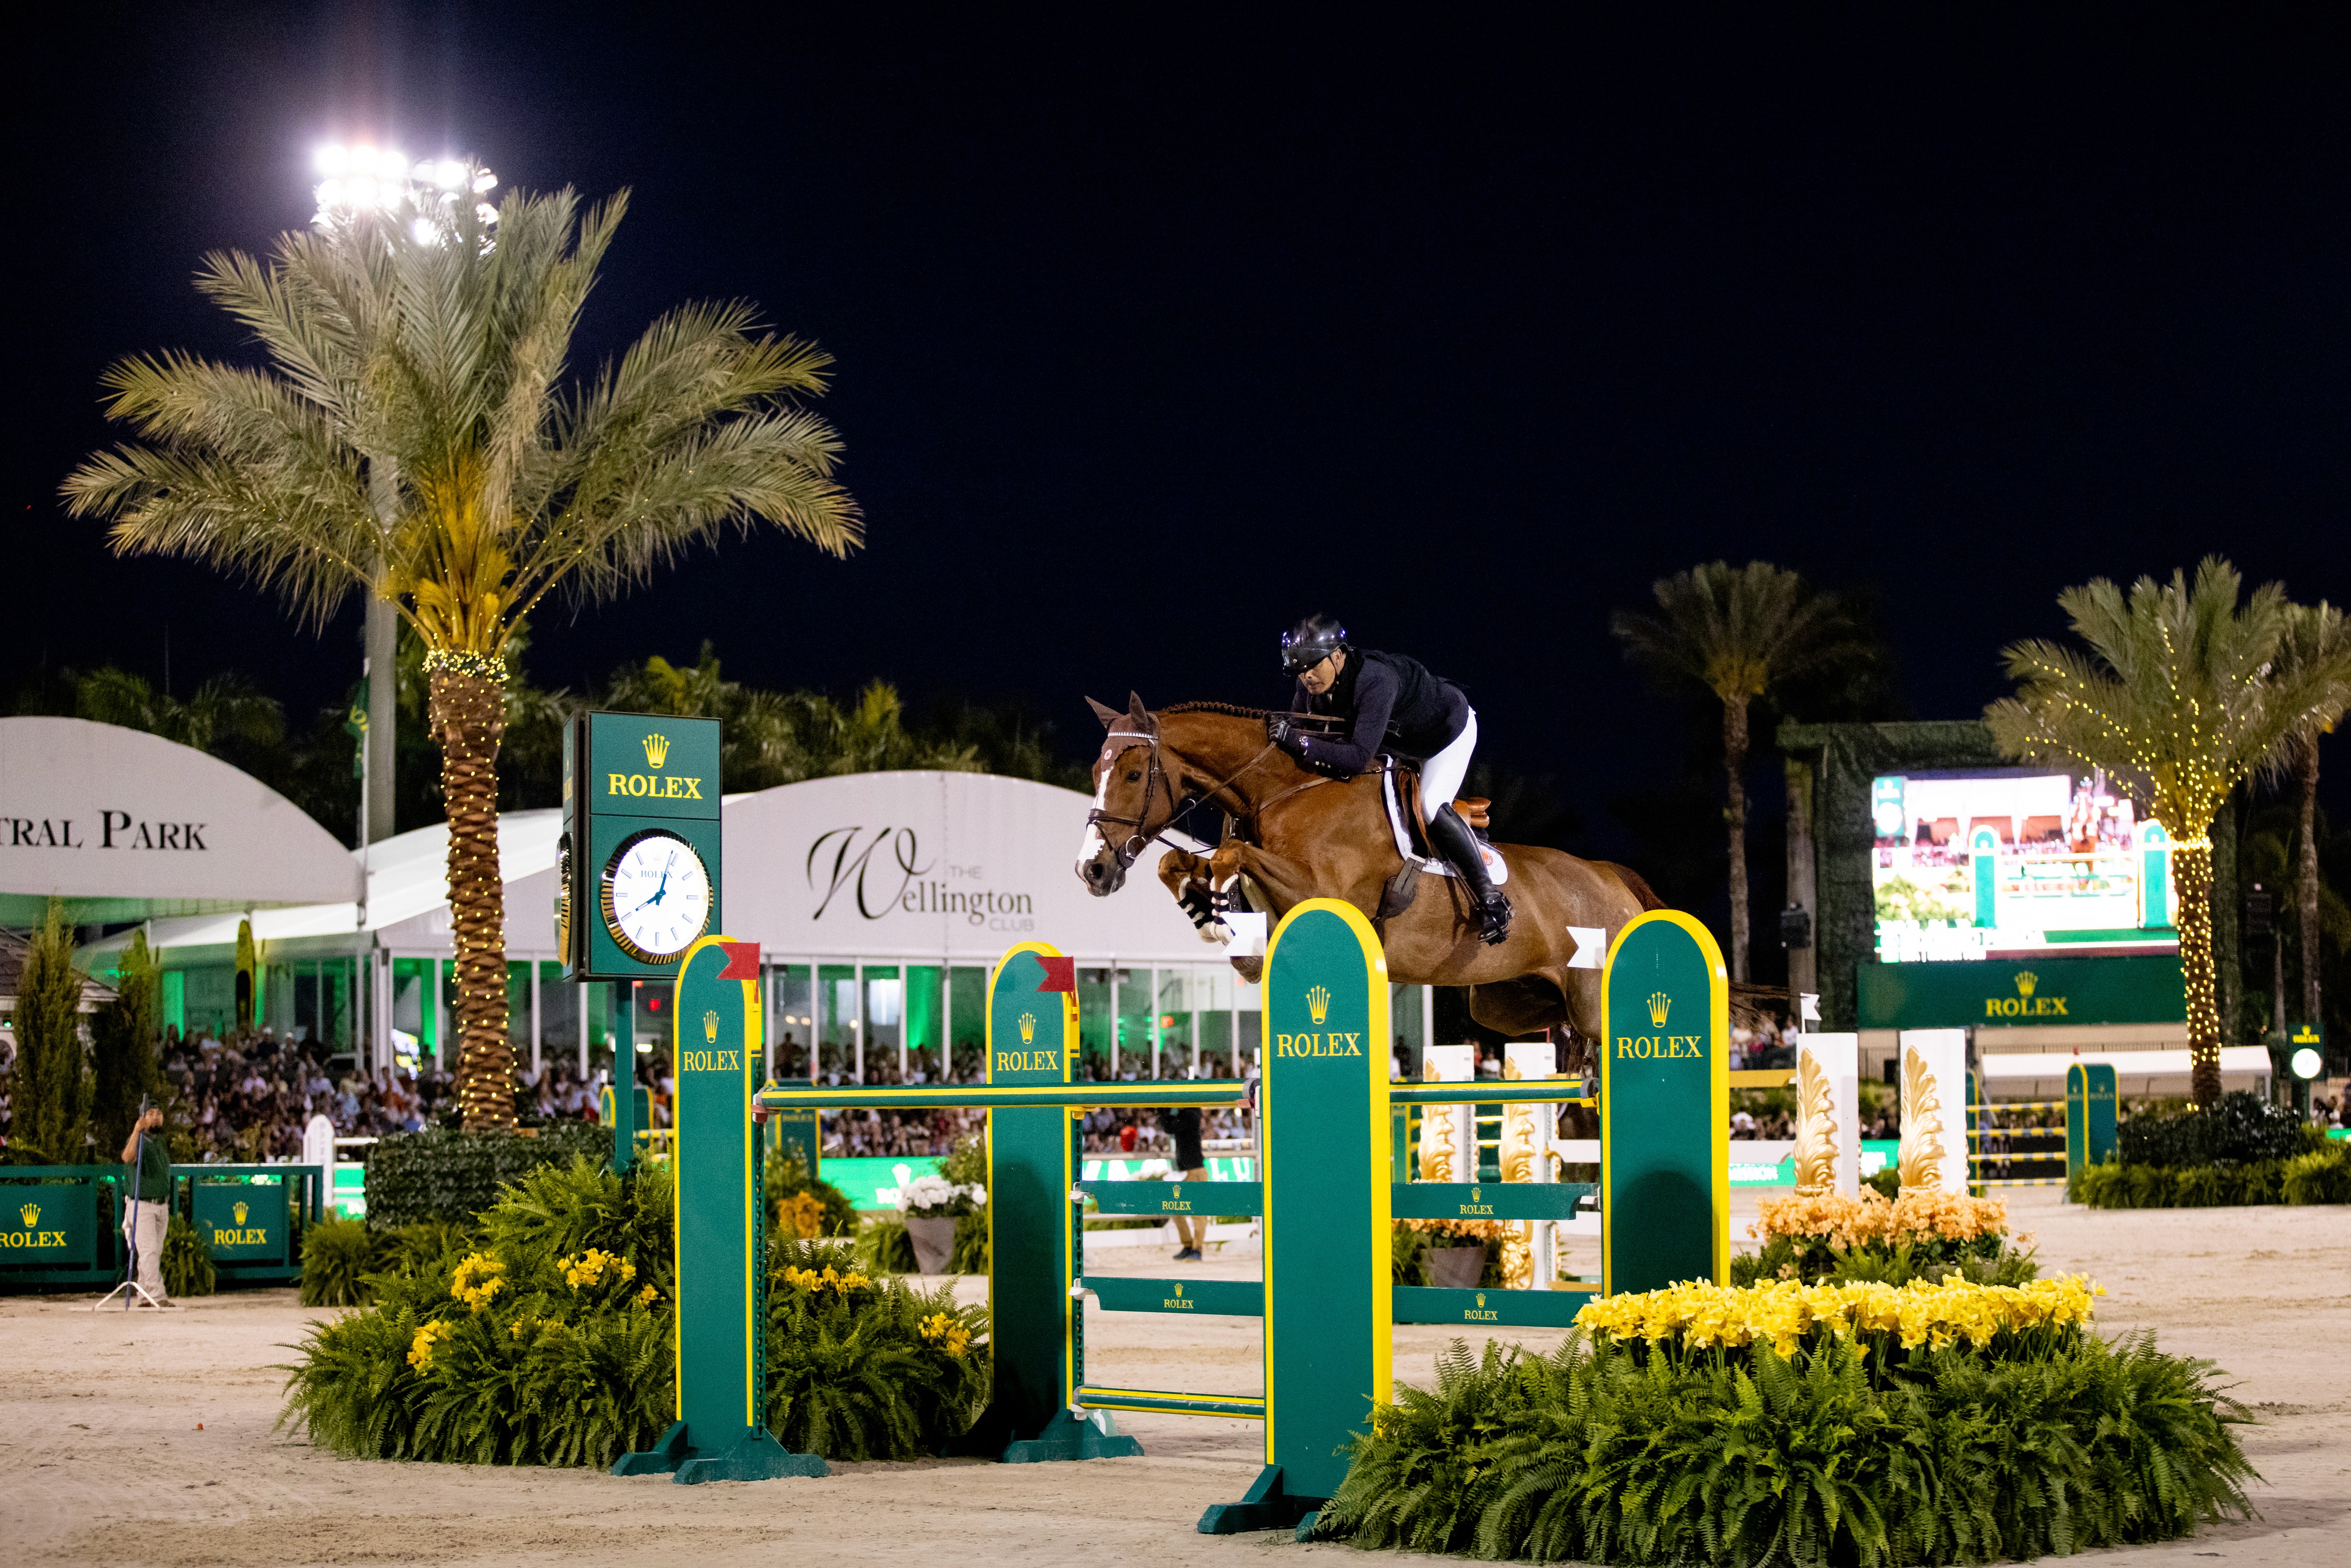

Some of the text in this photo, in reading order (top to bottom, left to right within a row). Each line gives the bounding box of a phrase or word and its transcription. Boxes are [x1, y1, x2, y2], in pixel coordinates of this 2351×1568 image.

[608, 773, 703, 800] ROLEX
[98, 809, 208, 851] PARK
[807, 826, 1033, 926] Wellington
[950, 865, 982, 880] THE
[988, 918, 1035, 932] CLUB
[1987, 997, 2068, 1016] ROLEX
[1277, 1033, 1362, 1057] ROLEX
[1617, 1036, 1703, 1058] ROLEX
[683, 1050, 740, 1071] ROLEX
[996, 1051, 1059, 1071] ROLEX
[1162, 1201, 1192, 1211] ROLEX
[1460, 1205, 1494, 1215] ROLEX
[0, 1231, 67, 1248] ROLEX
[214, 1229, 267, 1245] ROLEX
[1164, 1299, 1194, 1309] ROLEX
[1464, 1310, 1498, 1321] ROLEX
